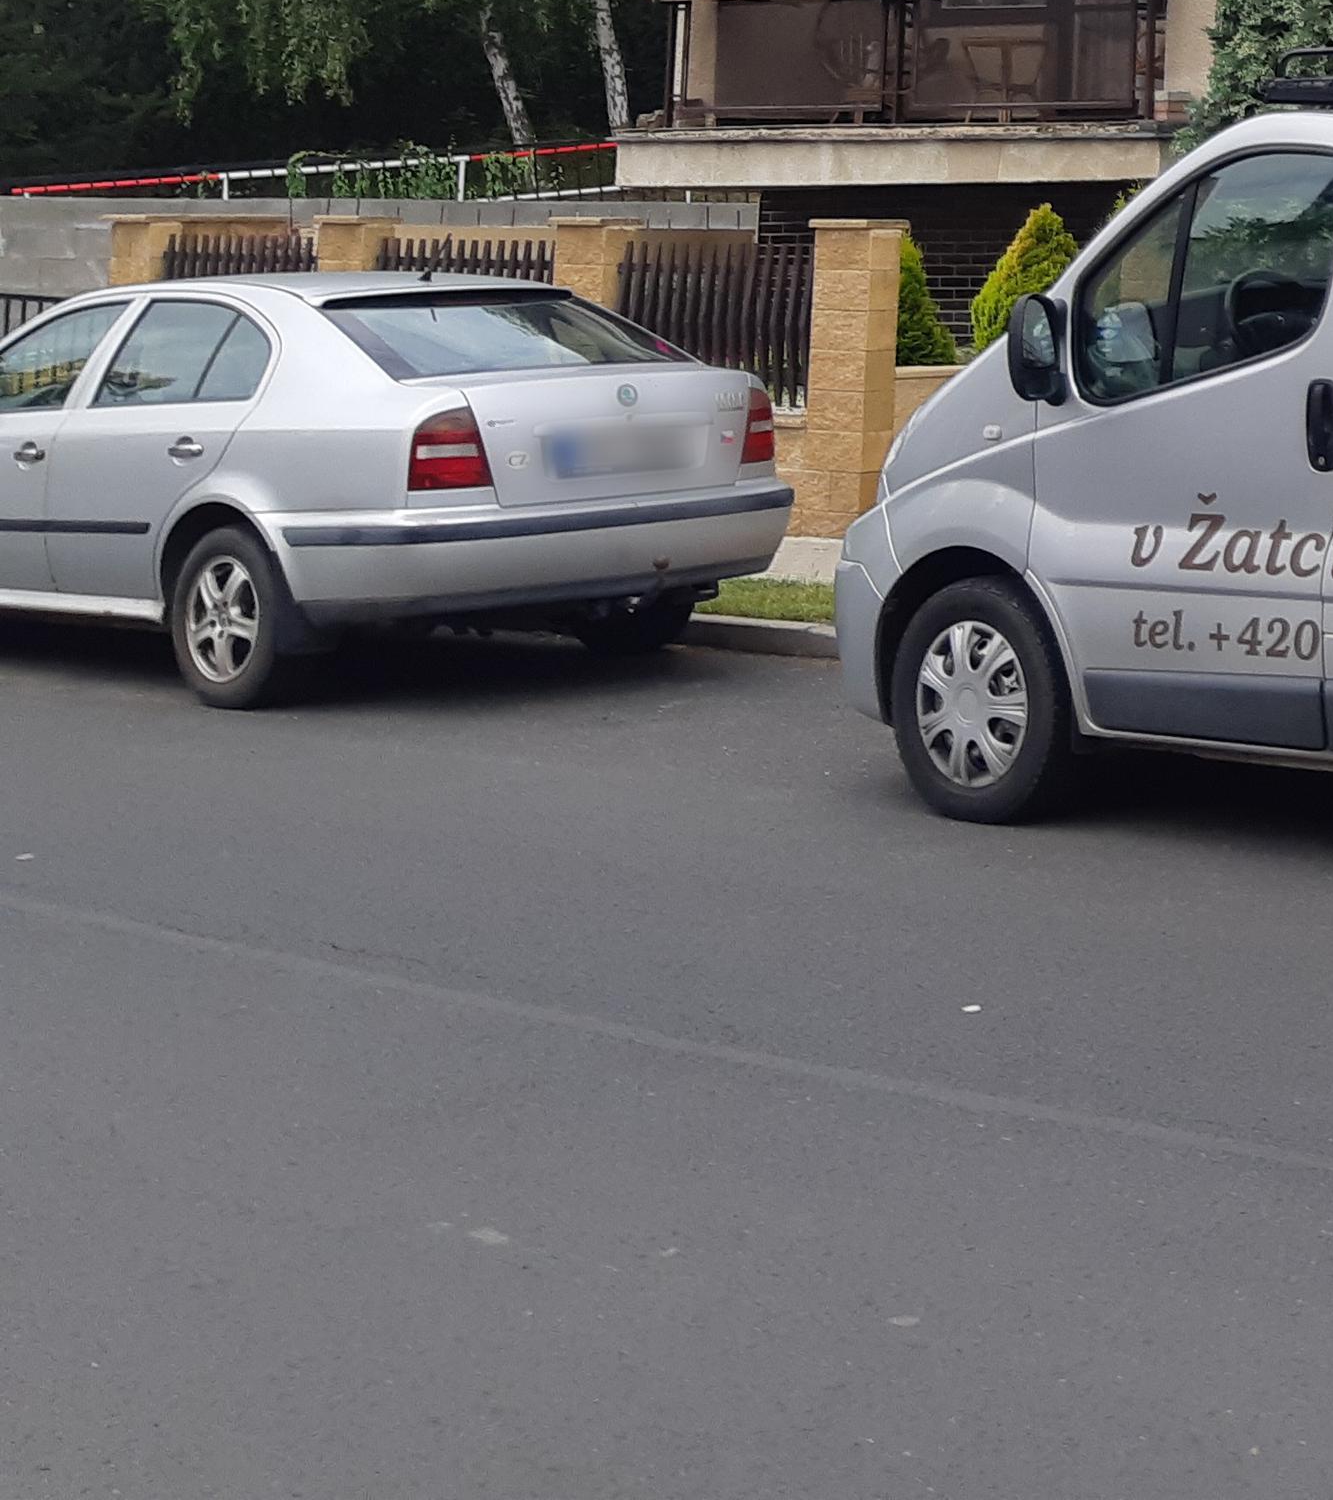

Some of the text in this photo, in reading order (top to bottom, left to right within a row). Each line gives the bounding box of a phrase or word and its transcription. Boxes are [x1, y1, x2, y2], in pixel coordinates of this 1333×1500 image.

[1130, 524, 1164, 568] v
[1132, 609, 1195, 651] tel.
[1209, 617, 1320, 661] +420
